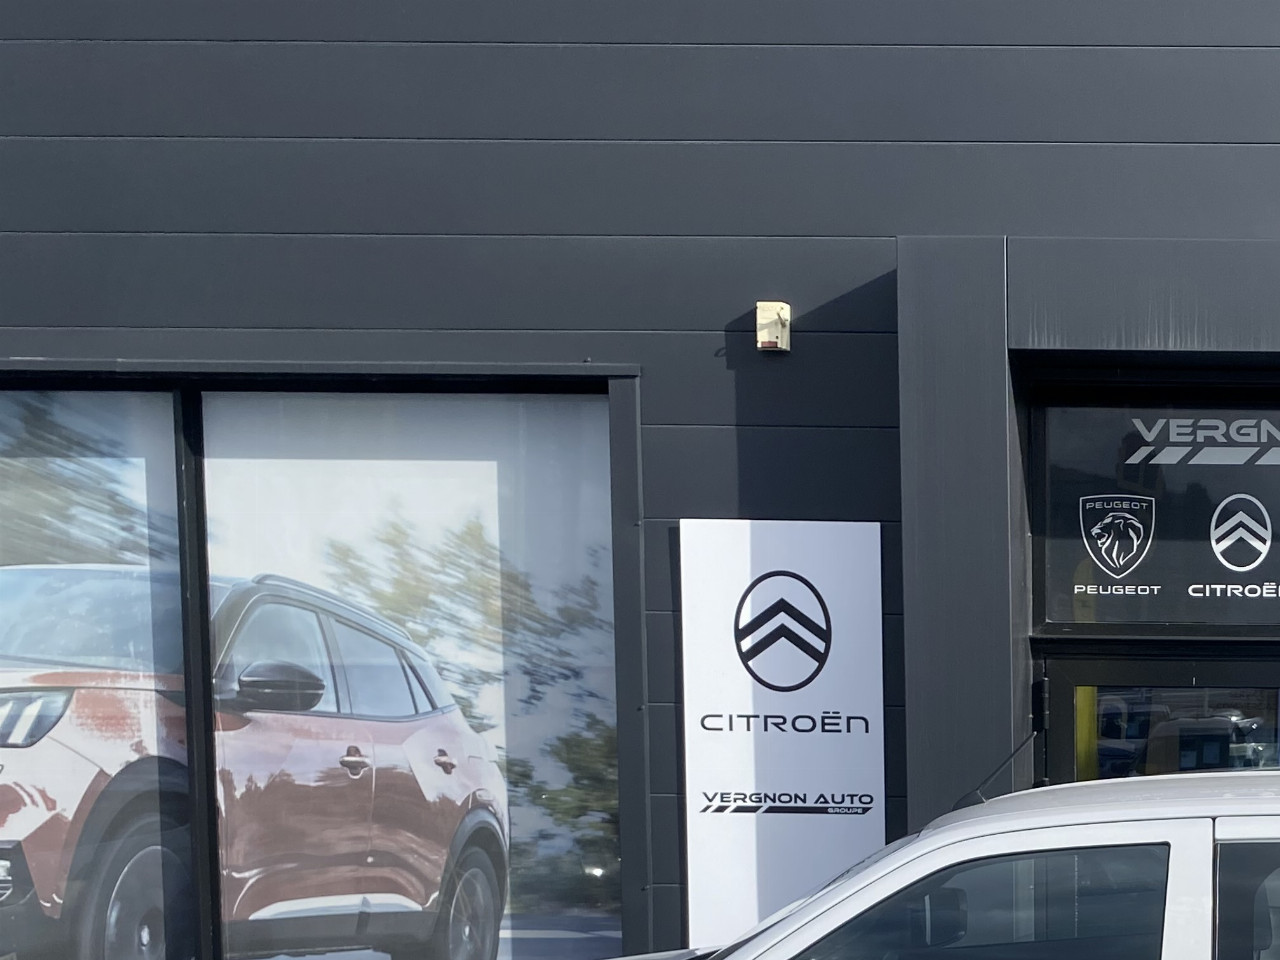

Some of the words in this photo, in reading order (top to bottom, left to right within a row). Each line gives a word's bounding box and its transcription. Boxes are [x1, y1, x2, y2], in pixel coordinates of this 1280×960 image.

[1086, 500, 1149, 512] PEUGEOT
[1074, 585, 1162, 595] PEUGEOT
[702, 791, 807, 804] VERGNON
[813, 793, 874, 805] AUTO
